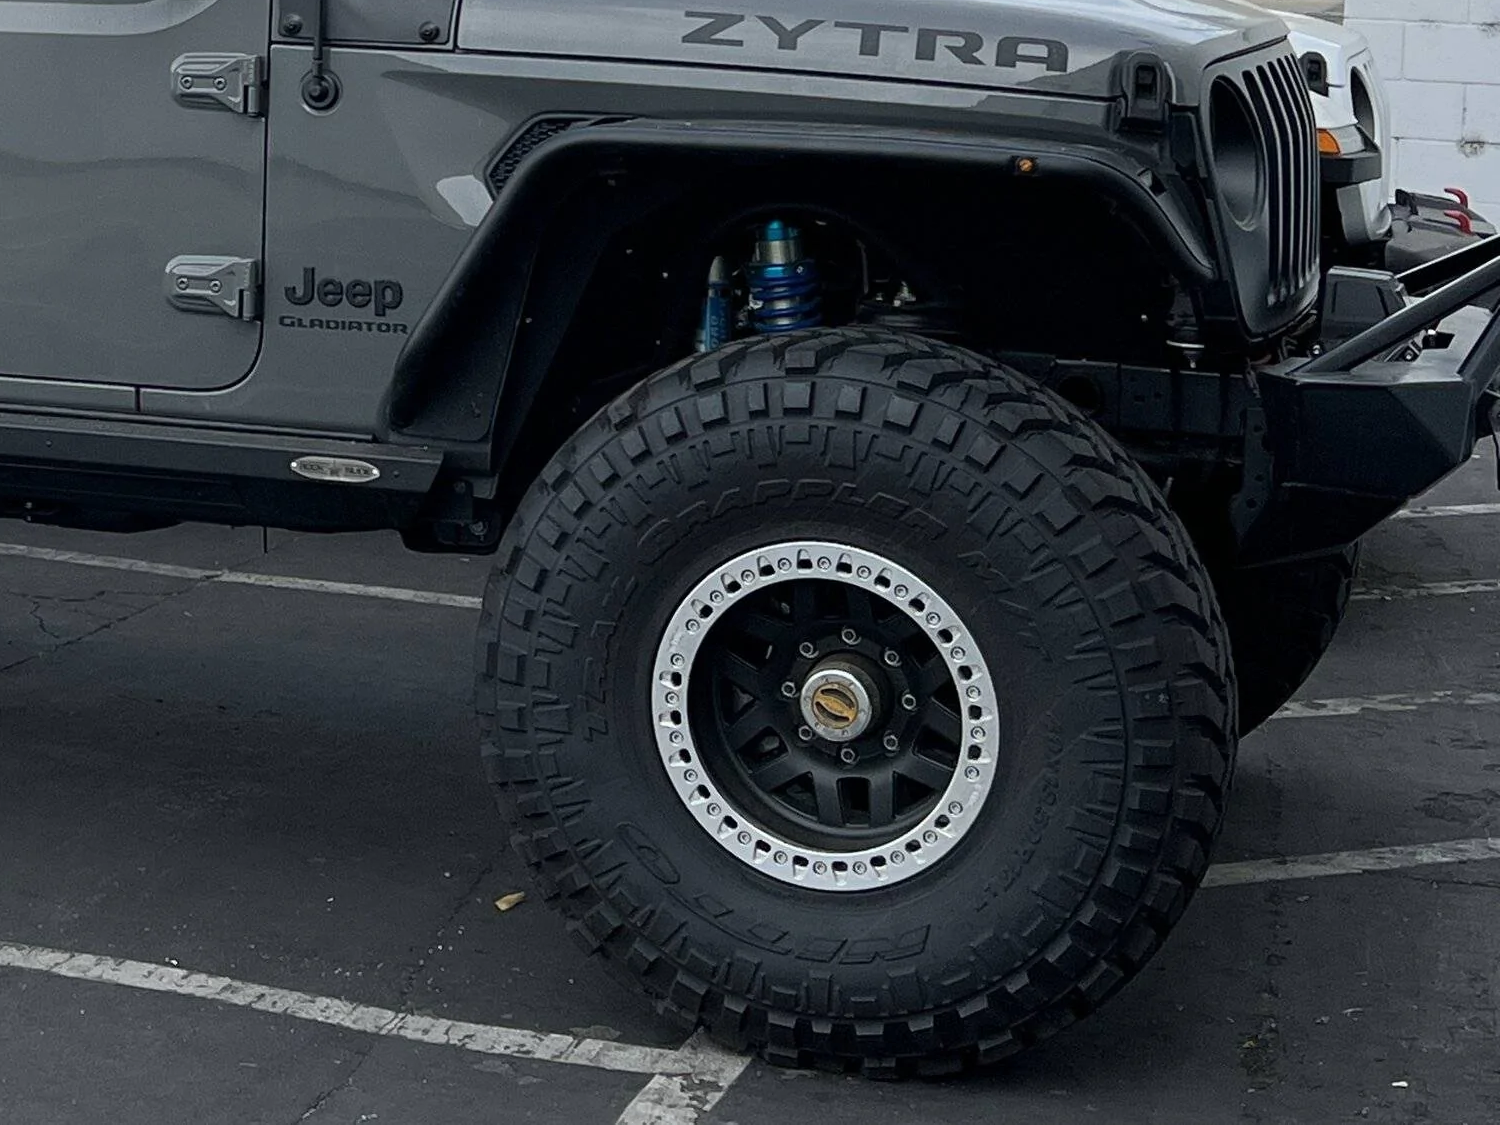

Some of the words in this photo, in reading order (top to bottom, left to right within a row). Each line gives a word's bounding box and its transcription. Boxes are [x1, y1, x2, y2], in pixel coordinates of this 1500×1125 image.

[681, 10, 1069, 73] ZYTRA
[284, 267, 403, 316] Jeep
[279, 315, 409, 335] GLADIATOR
